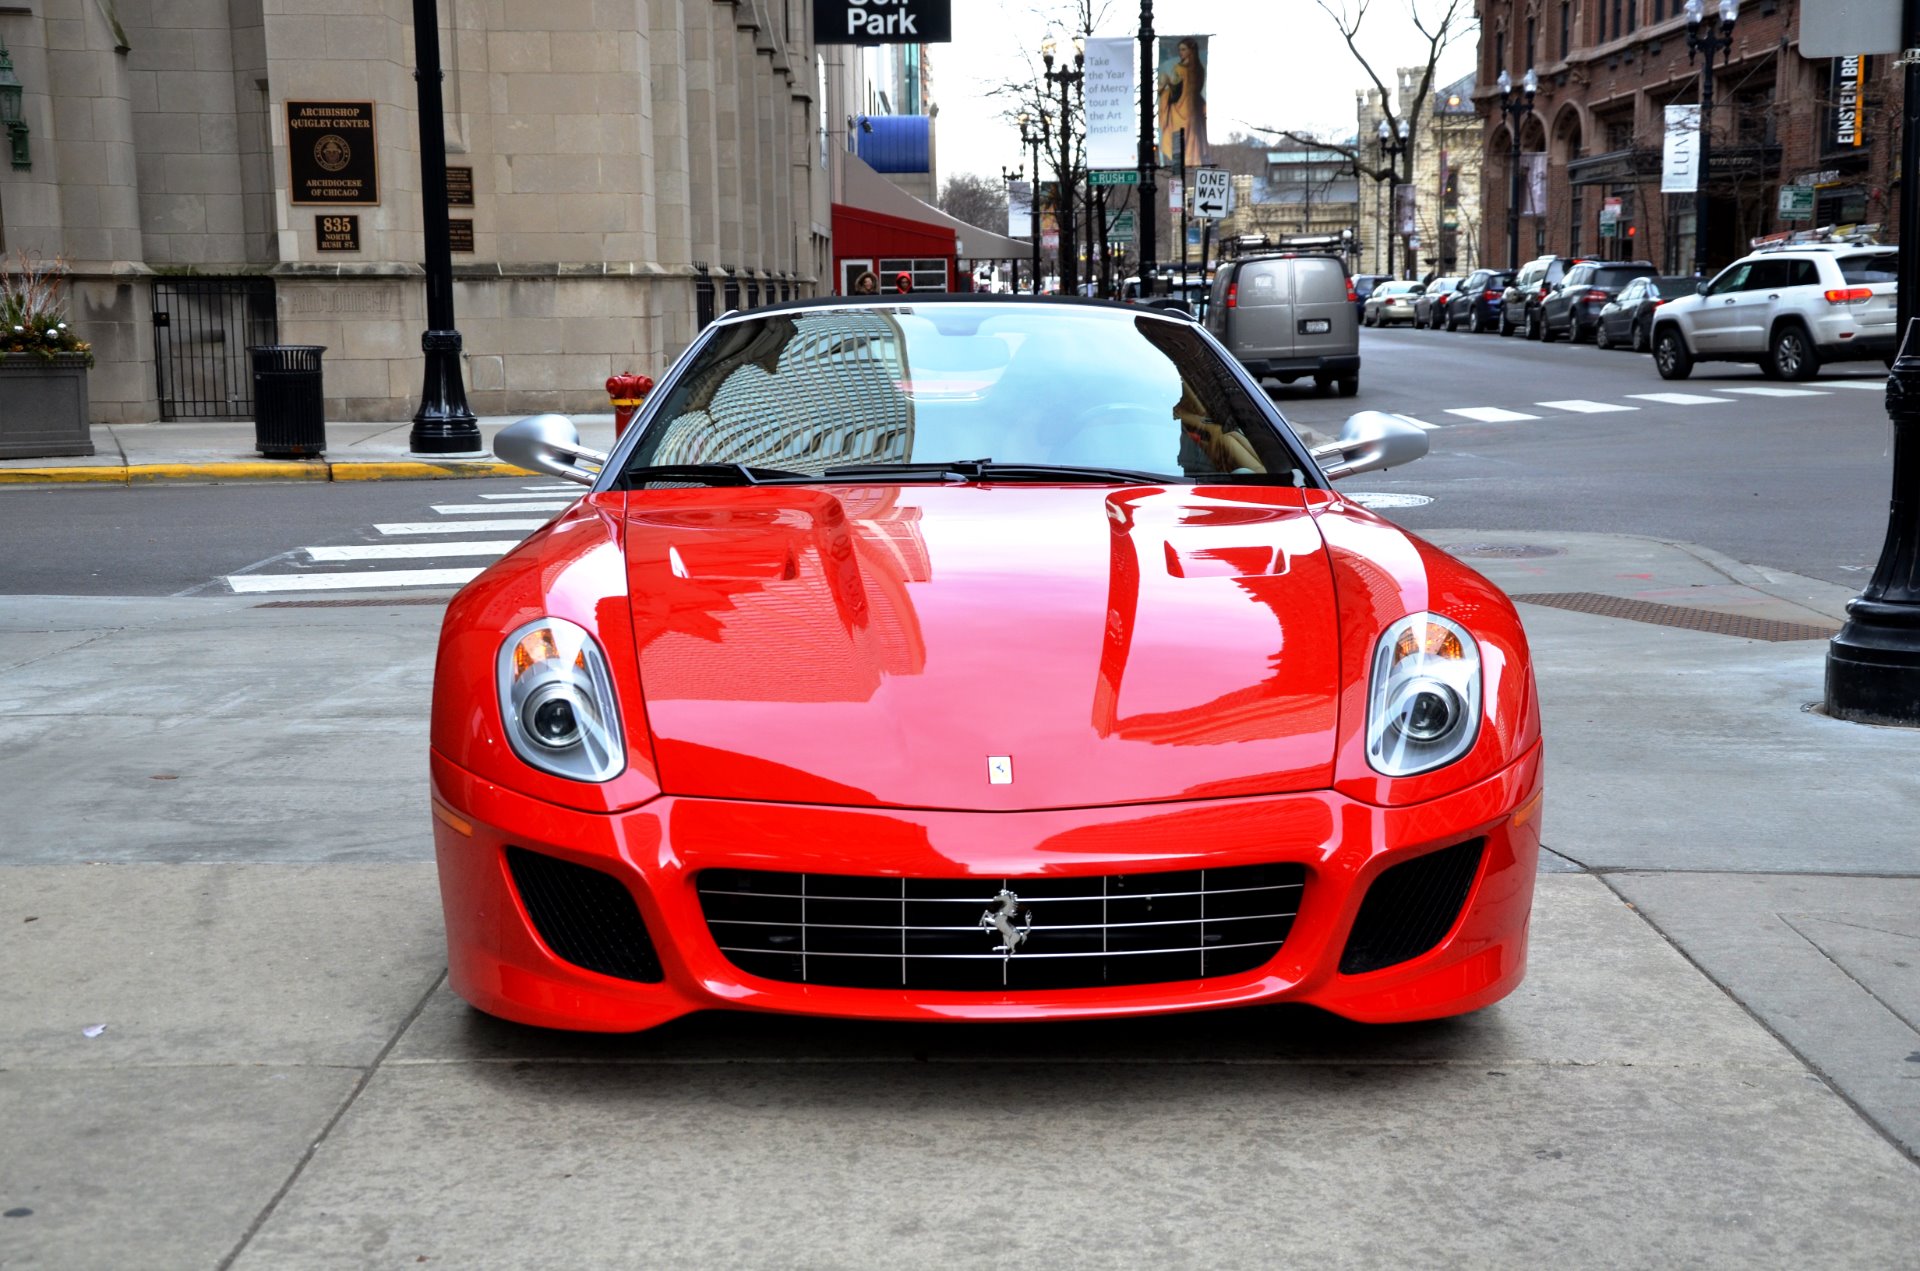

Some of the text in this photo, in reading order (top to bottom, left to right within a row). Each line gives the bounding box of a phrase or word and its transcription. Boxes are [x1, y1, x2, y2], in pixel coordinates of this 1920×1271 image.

[847, 7, 918, 35] Park
[1088, 56, 1110, 66] Take
[1088, 69, 1126, 80] the Year
[1088, 83, 1129, 94] of Mercy
[1089, 98, 1120, 108] tour at
[300, 108, 360, 117] ARCHBISHOP
[1089, 110, 1122, 121] the Art
[1837, 80, 1858, 144] EINSTEIN
[290, 119, 370, 129] QUIGLEY CENTER
[1090, 123, 1129, 135] Institute
[306, 179, 362, 187] ARCHDIOCESE
[1099, 173, 1125, 184] RUSH
[1199, 172, 1226, 186] ONE
[310, 188, 359, 197] OF CHICAGO
[1198, 186, 1225, 199] WAY
[323, 217, 351, 232] 835
[325, 233, 351, 241] NORTH
[321, 241, 342, 249] RUSH
